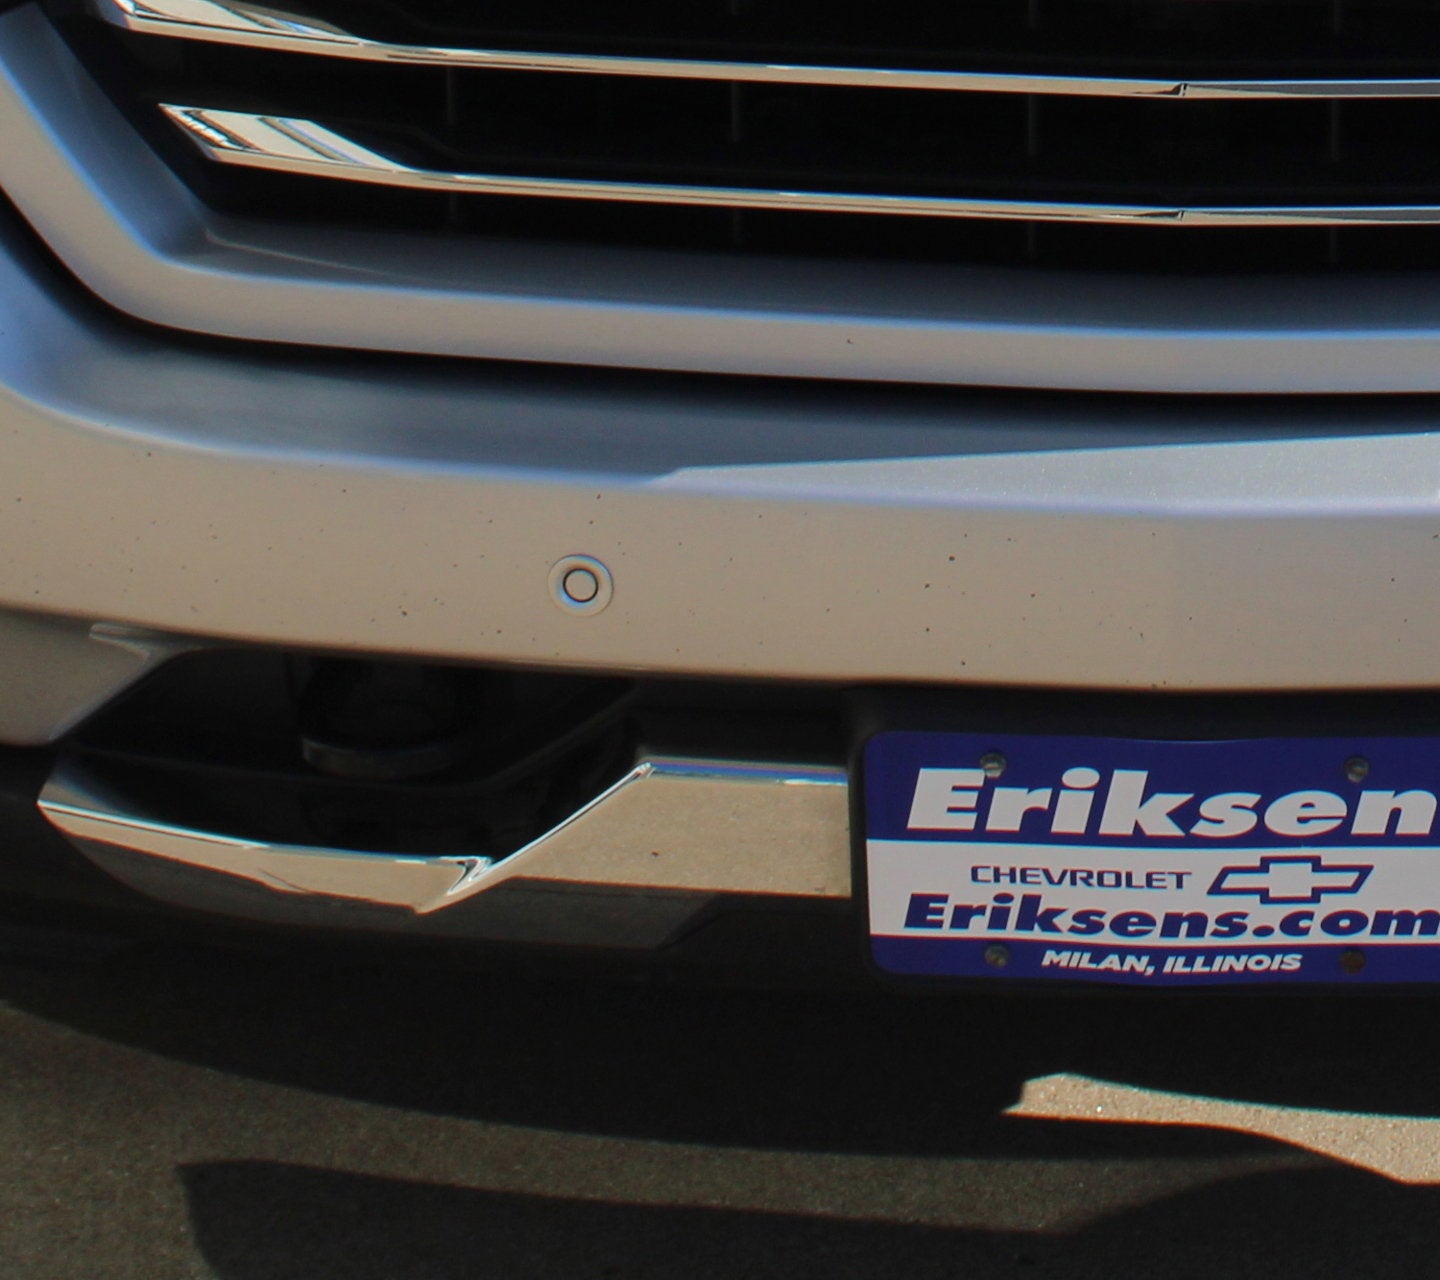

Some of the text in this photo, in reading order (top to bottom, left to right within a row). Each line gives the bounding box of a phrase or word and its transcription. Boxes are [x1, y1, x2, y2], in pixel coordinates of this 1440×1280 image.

[906, 767, 1438, 837] Eriksen
[970, 865, 1192, 890] CHEVROLET
[1041, 950, 1303, 977] MILAN, ILLINOIS
